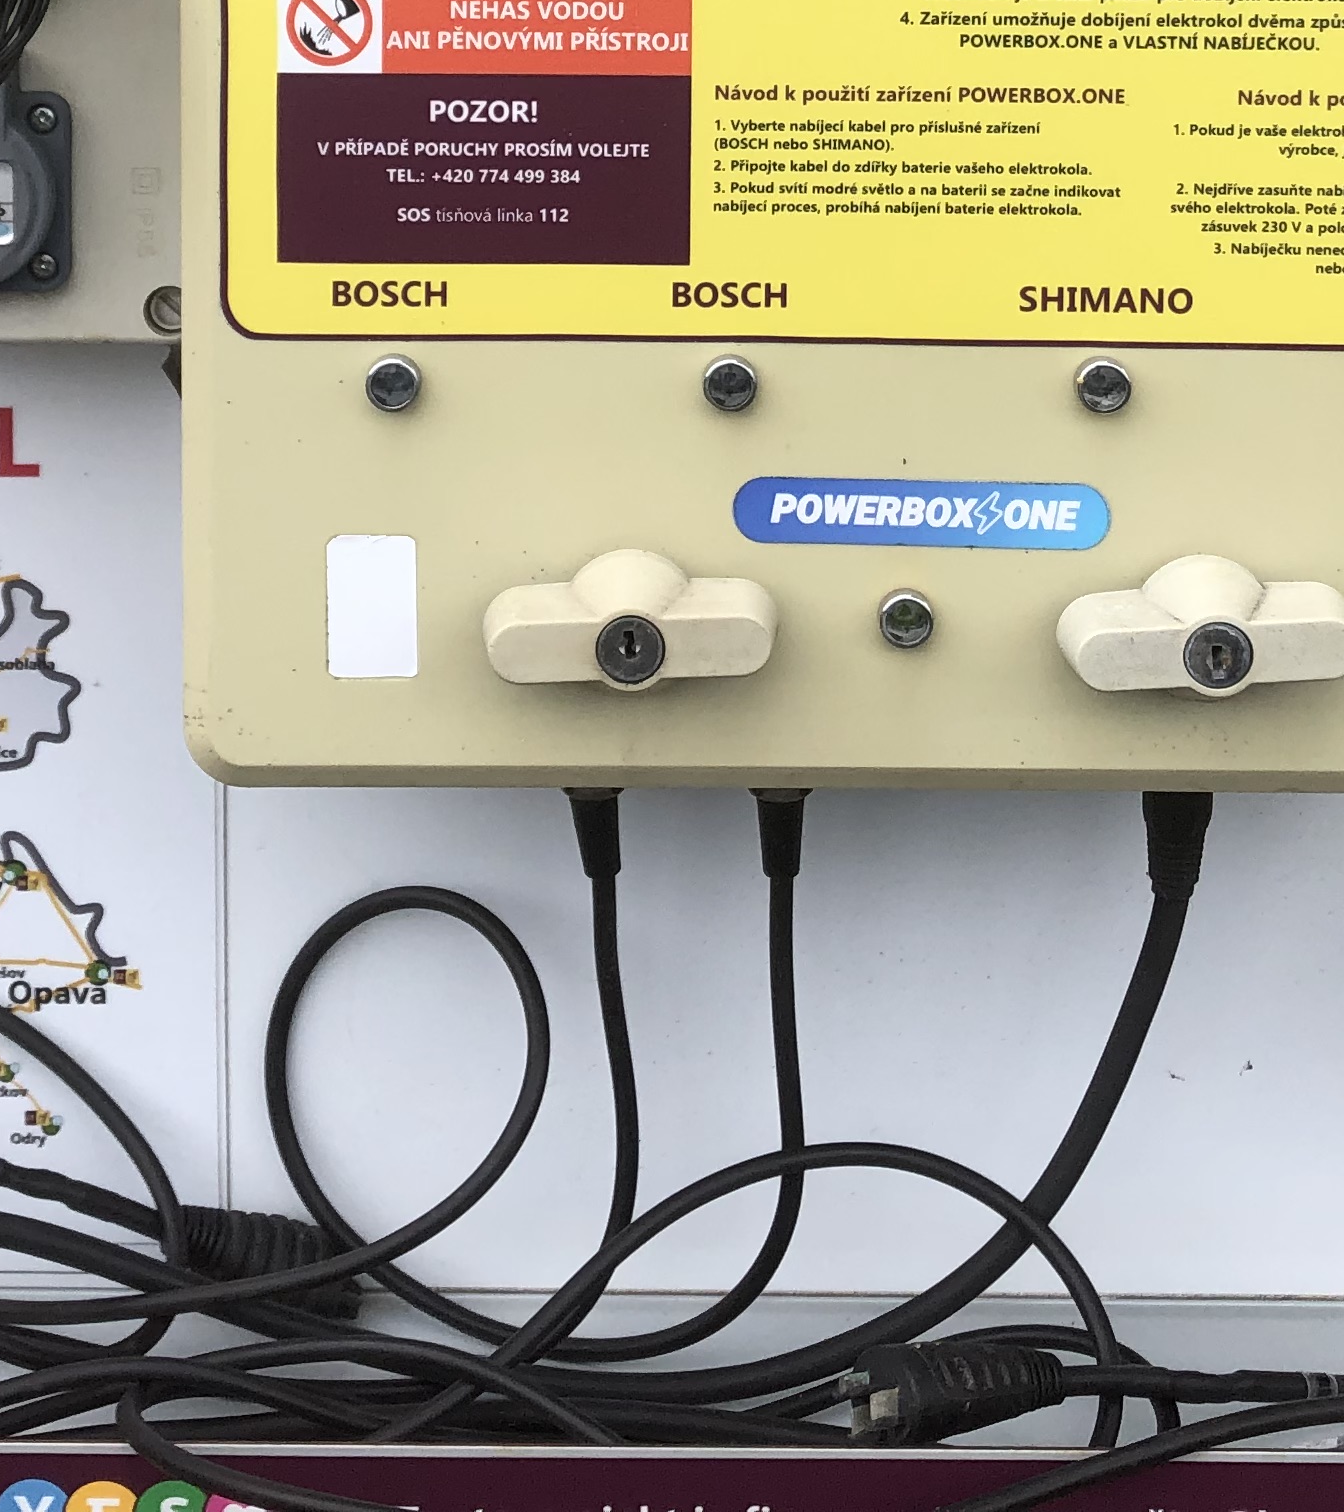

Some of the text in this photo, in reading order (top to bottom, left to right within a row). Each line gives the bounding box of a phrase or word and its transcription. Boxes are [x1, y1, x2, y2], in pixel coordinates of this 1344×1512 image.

[450, 0, 625, 21] NEHAS VODOU
[386, 25, 689, 53] ANI PĚNOVÝMI PŘÍSTROJI
[715, 84, 1126, 106] Návod k použití zařízení POWERBOX.ONE
[1238, 89, 1302, 107] Návod
[1309, 89, 1321, 107] k
[429, 99, 538, 123] POZOR!
[317, 137, 650, 158] V PŘÍPADĚ PORUCHY PROSÍM VOLEJTE
[385, 168, 581, 184] TEL.: +420 774 499 384
[396, 207, 569, 223] SOS tísňová linka 112
[332, 280, 448, 308] BOSCH
[672, 281, 788, 309] BOSCH
[1019, 285, 1194, 315] SHIMANO
[771, 492, 1081, 535] POWERBOX ONE
[8, 981, 106, 1011] Opava
